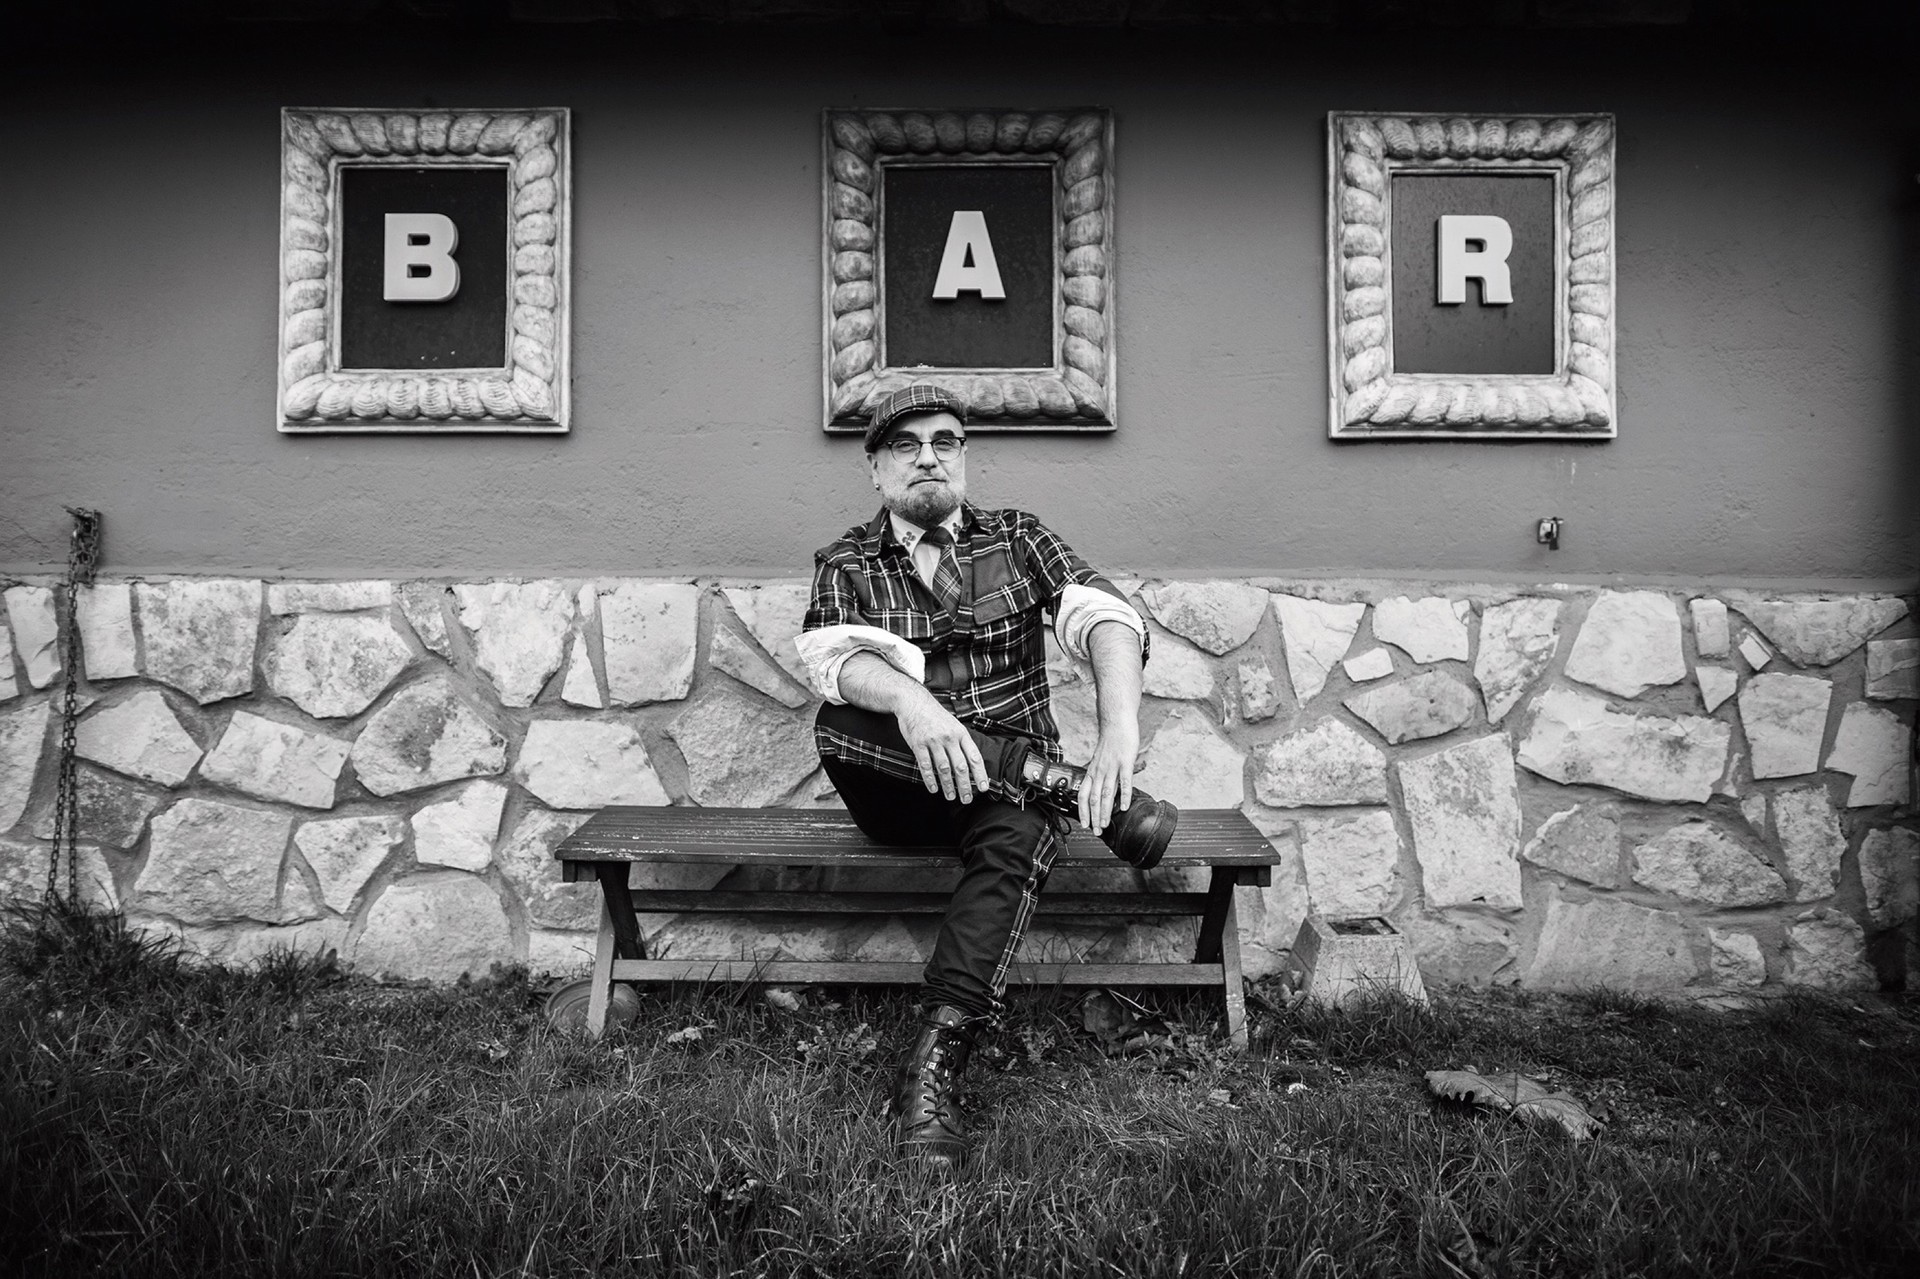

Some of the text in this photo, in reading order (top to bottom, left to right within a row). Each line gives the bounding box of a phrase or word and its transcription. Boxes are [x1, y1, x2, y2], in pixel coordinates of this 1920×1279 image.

[384, 210, 1514, 305] B A R
